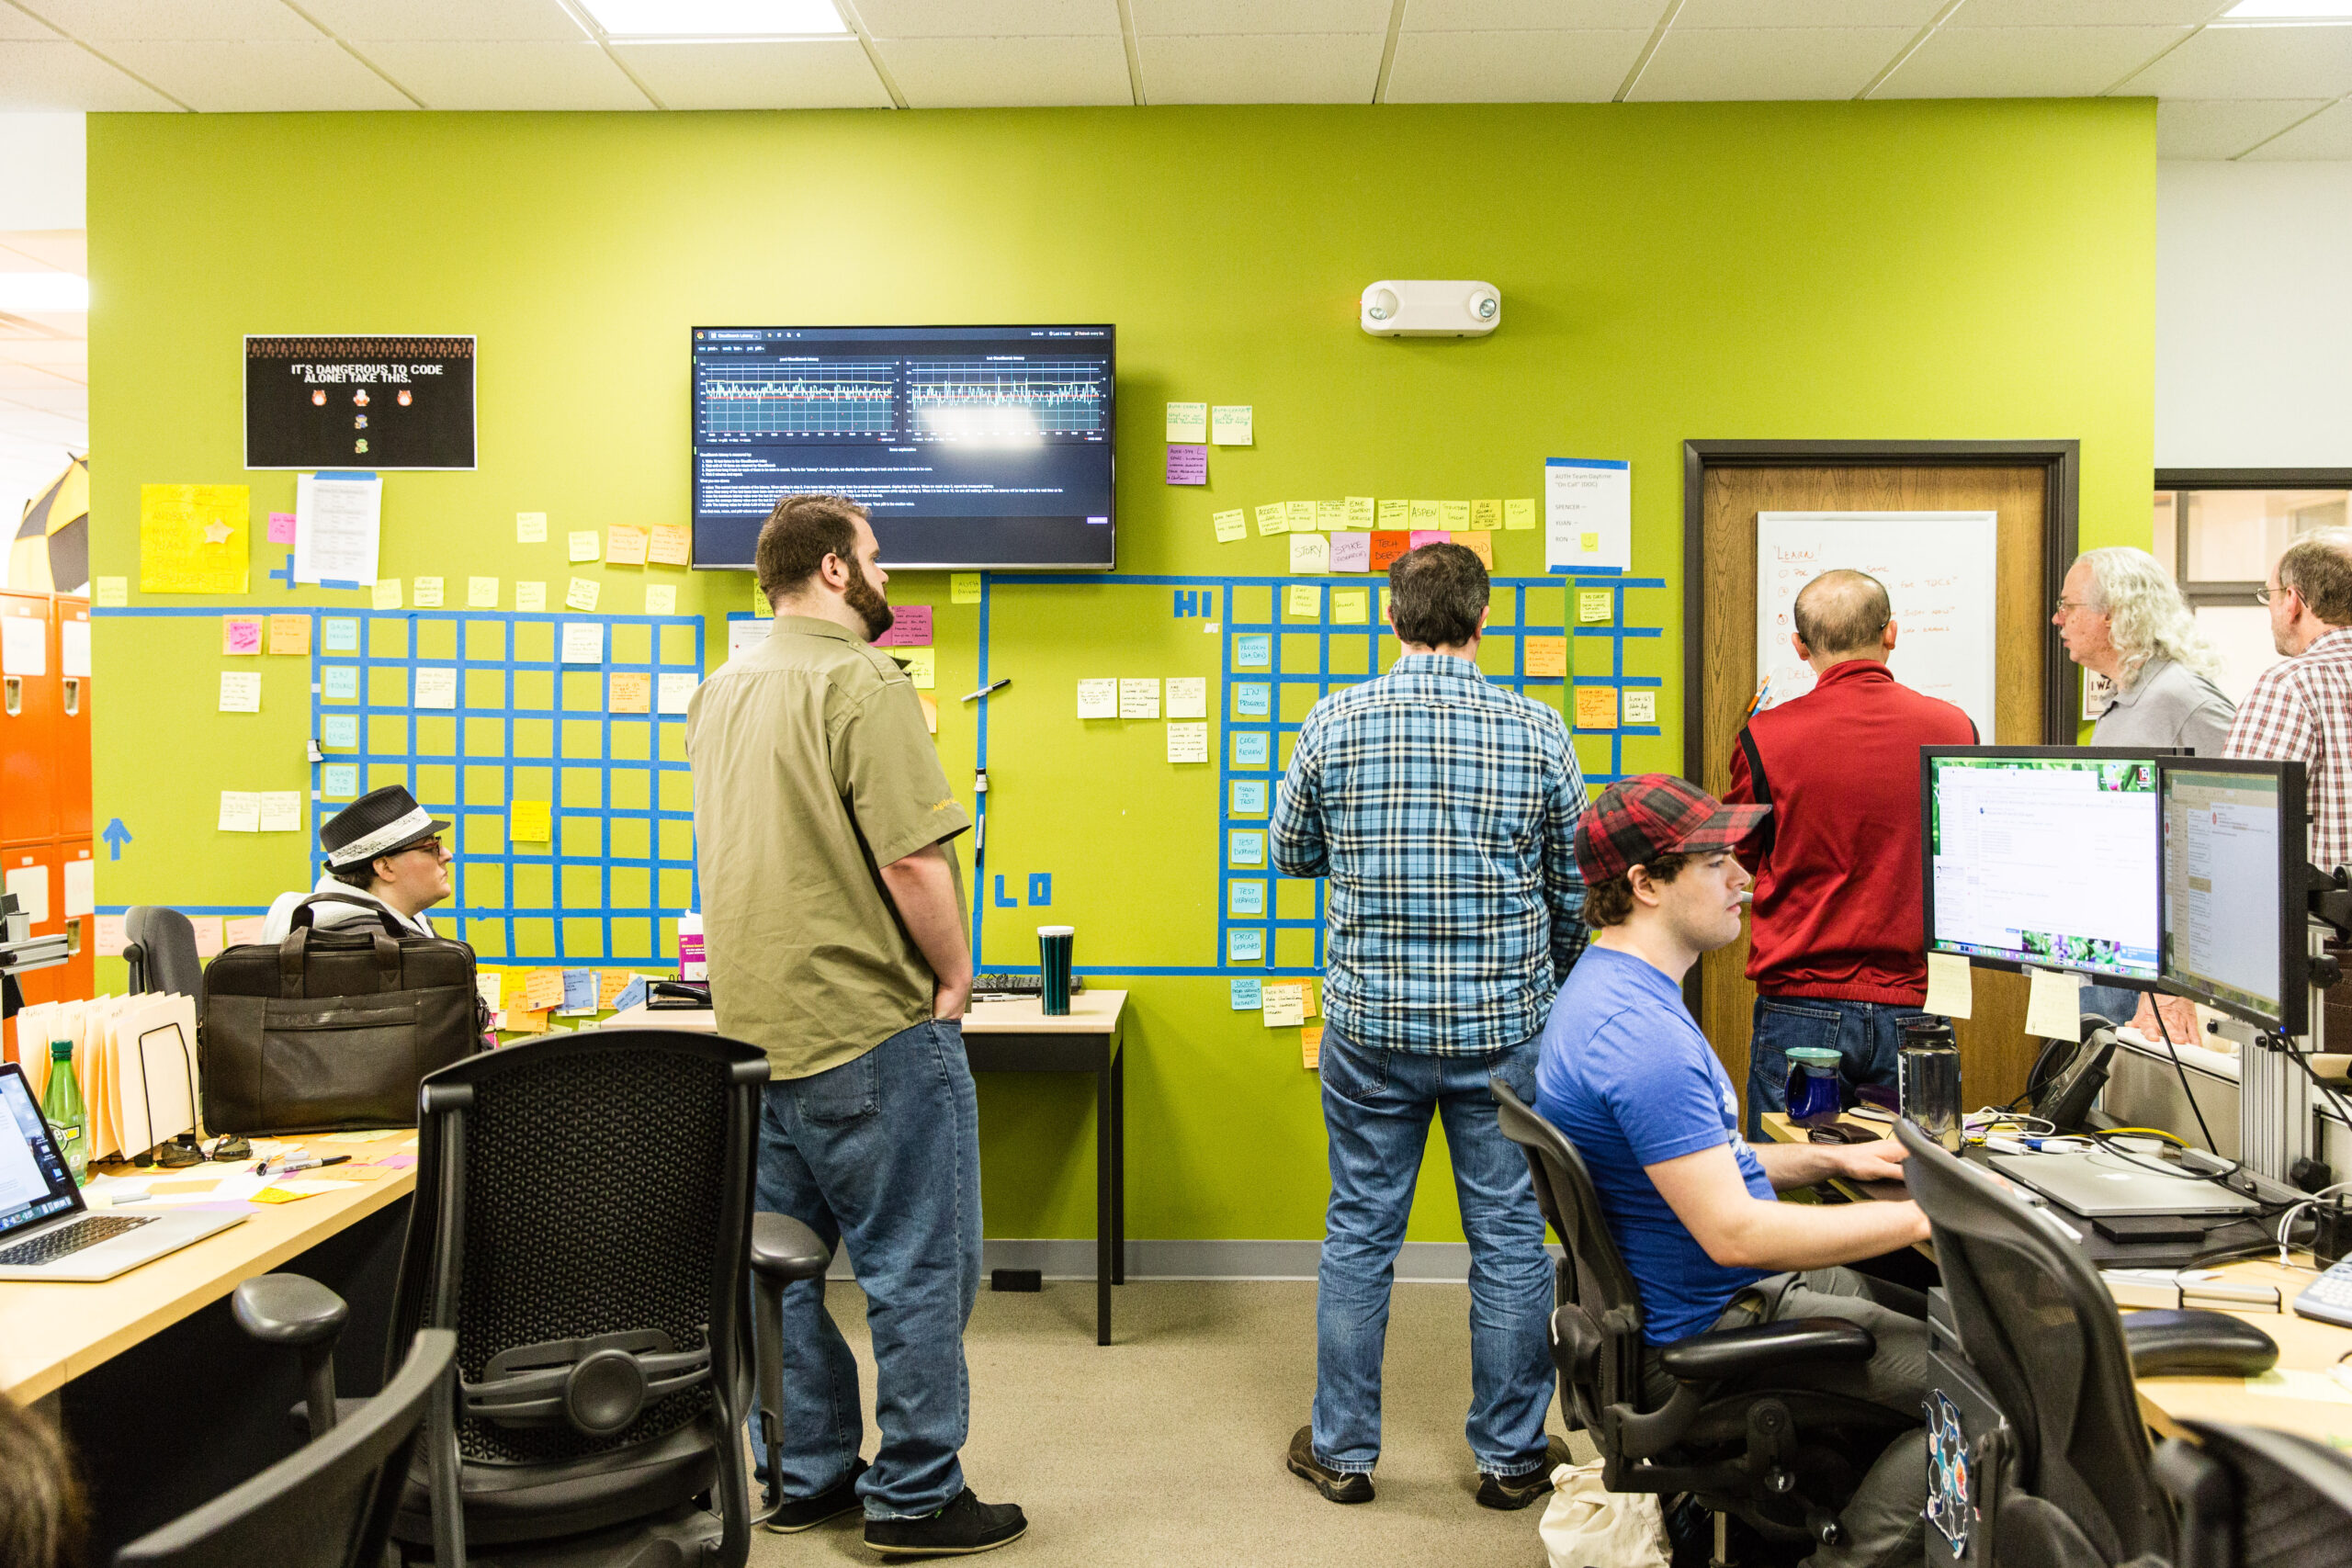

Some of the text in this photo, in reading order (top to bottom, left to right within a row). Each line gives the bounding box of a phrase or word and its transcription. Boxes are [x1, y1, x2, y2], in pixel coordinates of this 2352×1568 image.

[291, 364, 443, 376] IT'S DANGEROUS TO CODE
[304, 373, 412, 383] ALONE! TAKE THIS.
[1411, 506, 1436, 517] ASPEN
[153, 527, 178, 537] MIKE
[1295, 544, 1322, 559] STORY
[1334, 540, 1363, 556] SPIKE
[1173, 590, 1213, 618] HI
[1242, 687, 1260, 696] IN
[1238, 699, 1267, 708] PROGRESS
[1238, 737, 1259, 746] CODE
[1238, 747, 1264, 757] REVIEW
[1238, 839, 1255, 847] TEST
[994, 873, 1052, 908] LO
[1238, 887, 1256, 896] TEST
